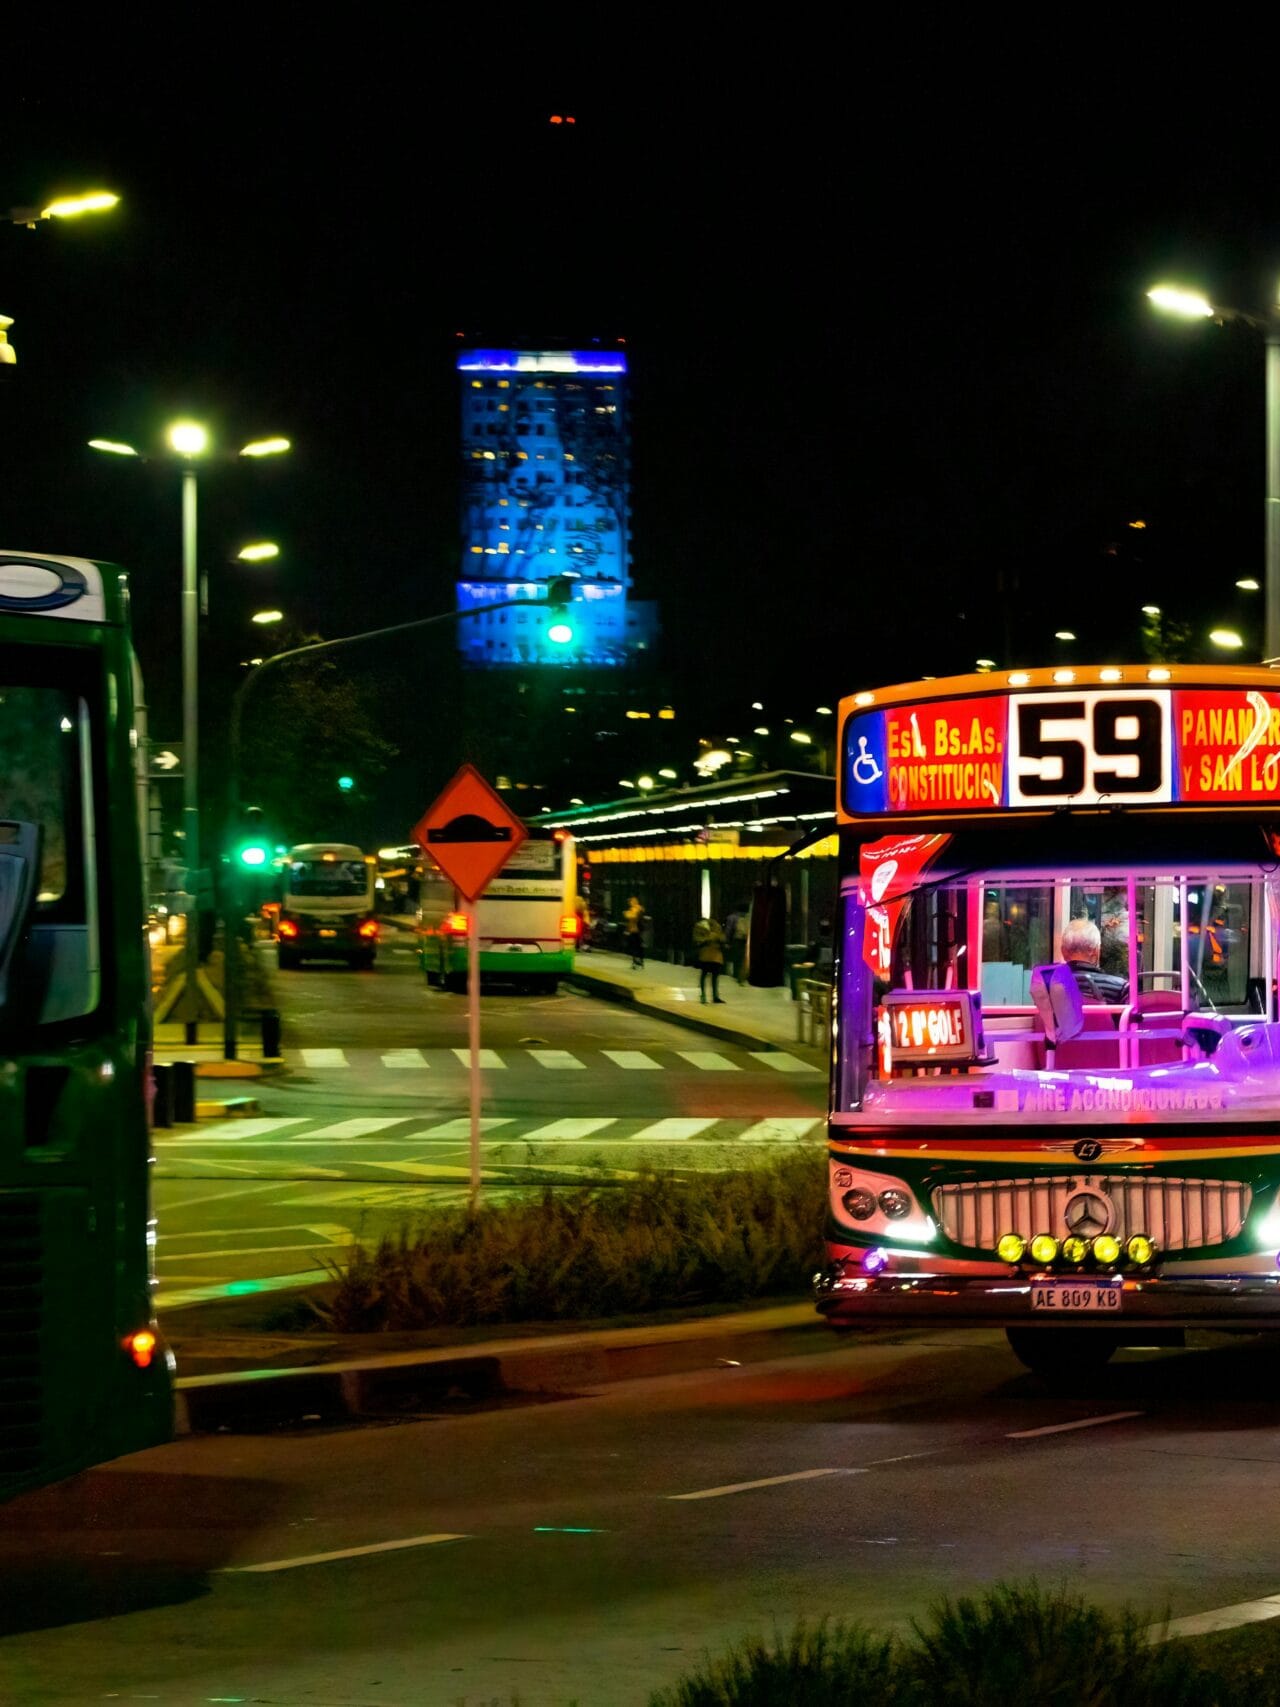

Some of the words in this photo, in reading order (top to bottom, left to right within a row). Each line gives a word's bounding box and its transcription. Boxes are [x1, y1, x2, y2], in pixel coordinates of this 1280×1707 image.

[1018, 699, 1163, 797] 59
[888, 762, 1002, 802] CONSTITUCION
[1200, 753, 1242, 792] SAN
[927, 1008, 963, 1046] GOLF
[1036, 1289, 1056, 1307] AE
[1061, 1290, 1092, 1308] 809
[1097, 1290, 1118, 1307] KB
